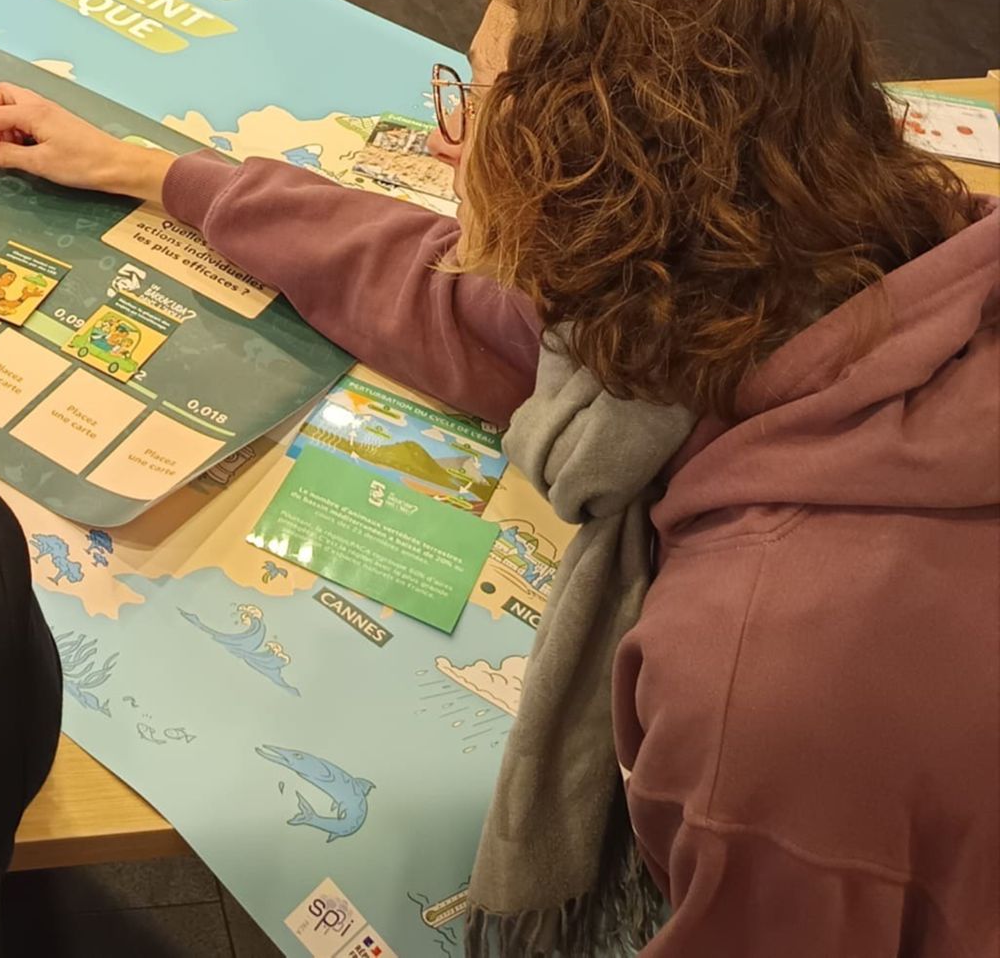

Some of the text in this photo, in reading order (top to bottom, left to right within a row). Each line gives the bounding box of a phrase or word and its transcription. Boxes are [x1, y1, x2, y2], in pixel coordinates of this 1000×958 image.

[162, 219, 209, 246] Quelles
[133, 232, 151, 246] les
[152, 242, 180, 261] plus
[182, 256, 238, 292] efficaces
[136, 222, 266, 291] actions individuelles
[66, 404, 98, 427] Placez
[186, 399, 228, 425] 0,018
[349, 382, 413, 412] PERTURBATION
[414, 408, 428, 418] DU
[429, 413, 456, 429] CYCLE
[457, 425, 470, 434] DE
[50, 408, 97, 440] une carte
[128, 453, 176, 477] une carte
[144, 448, 176, 466] Placez
[319, 592, 386, 642] CANNES
[510, 602, 542, 627] NIC
